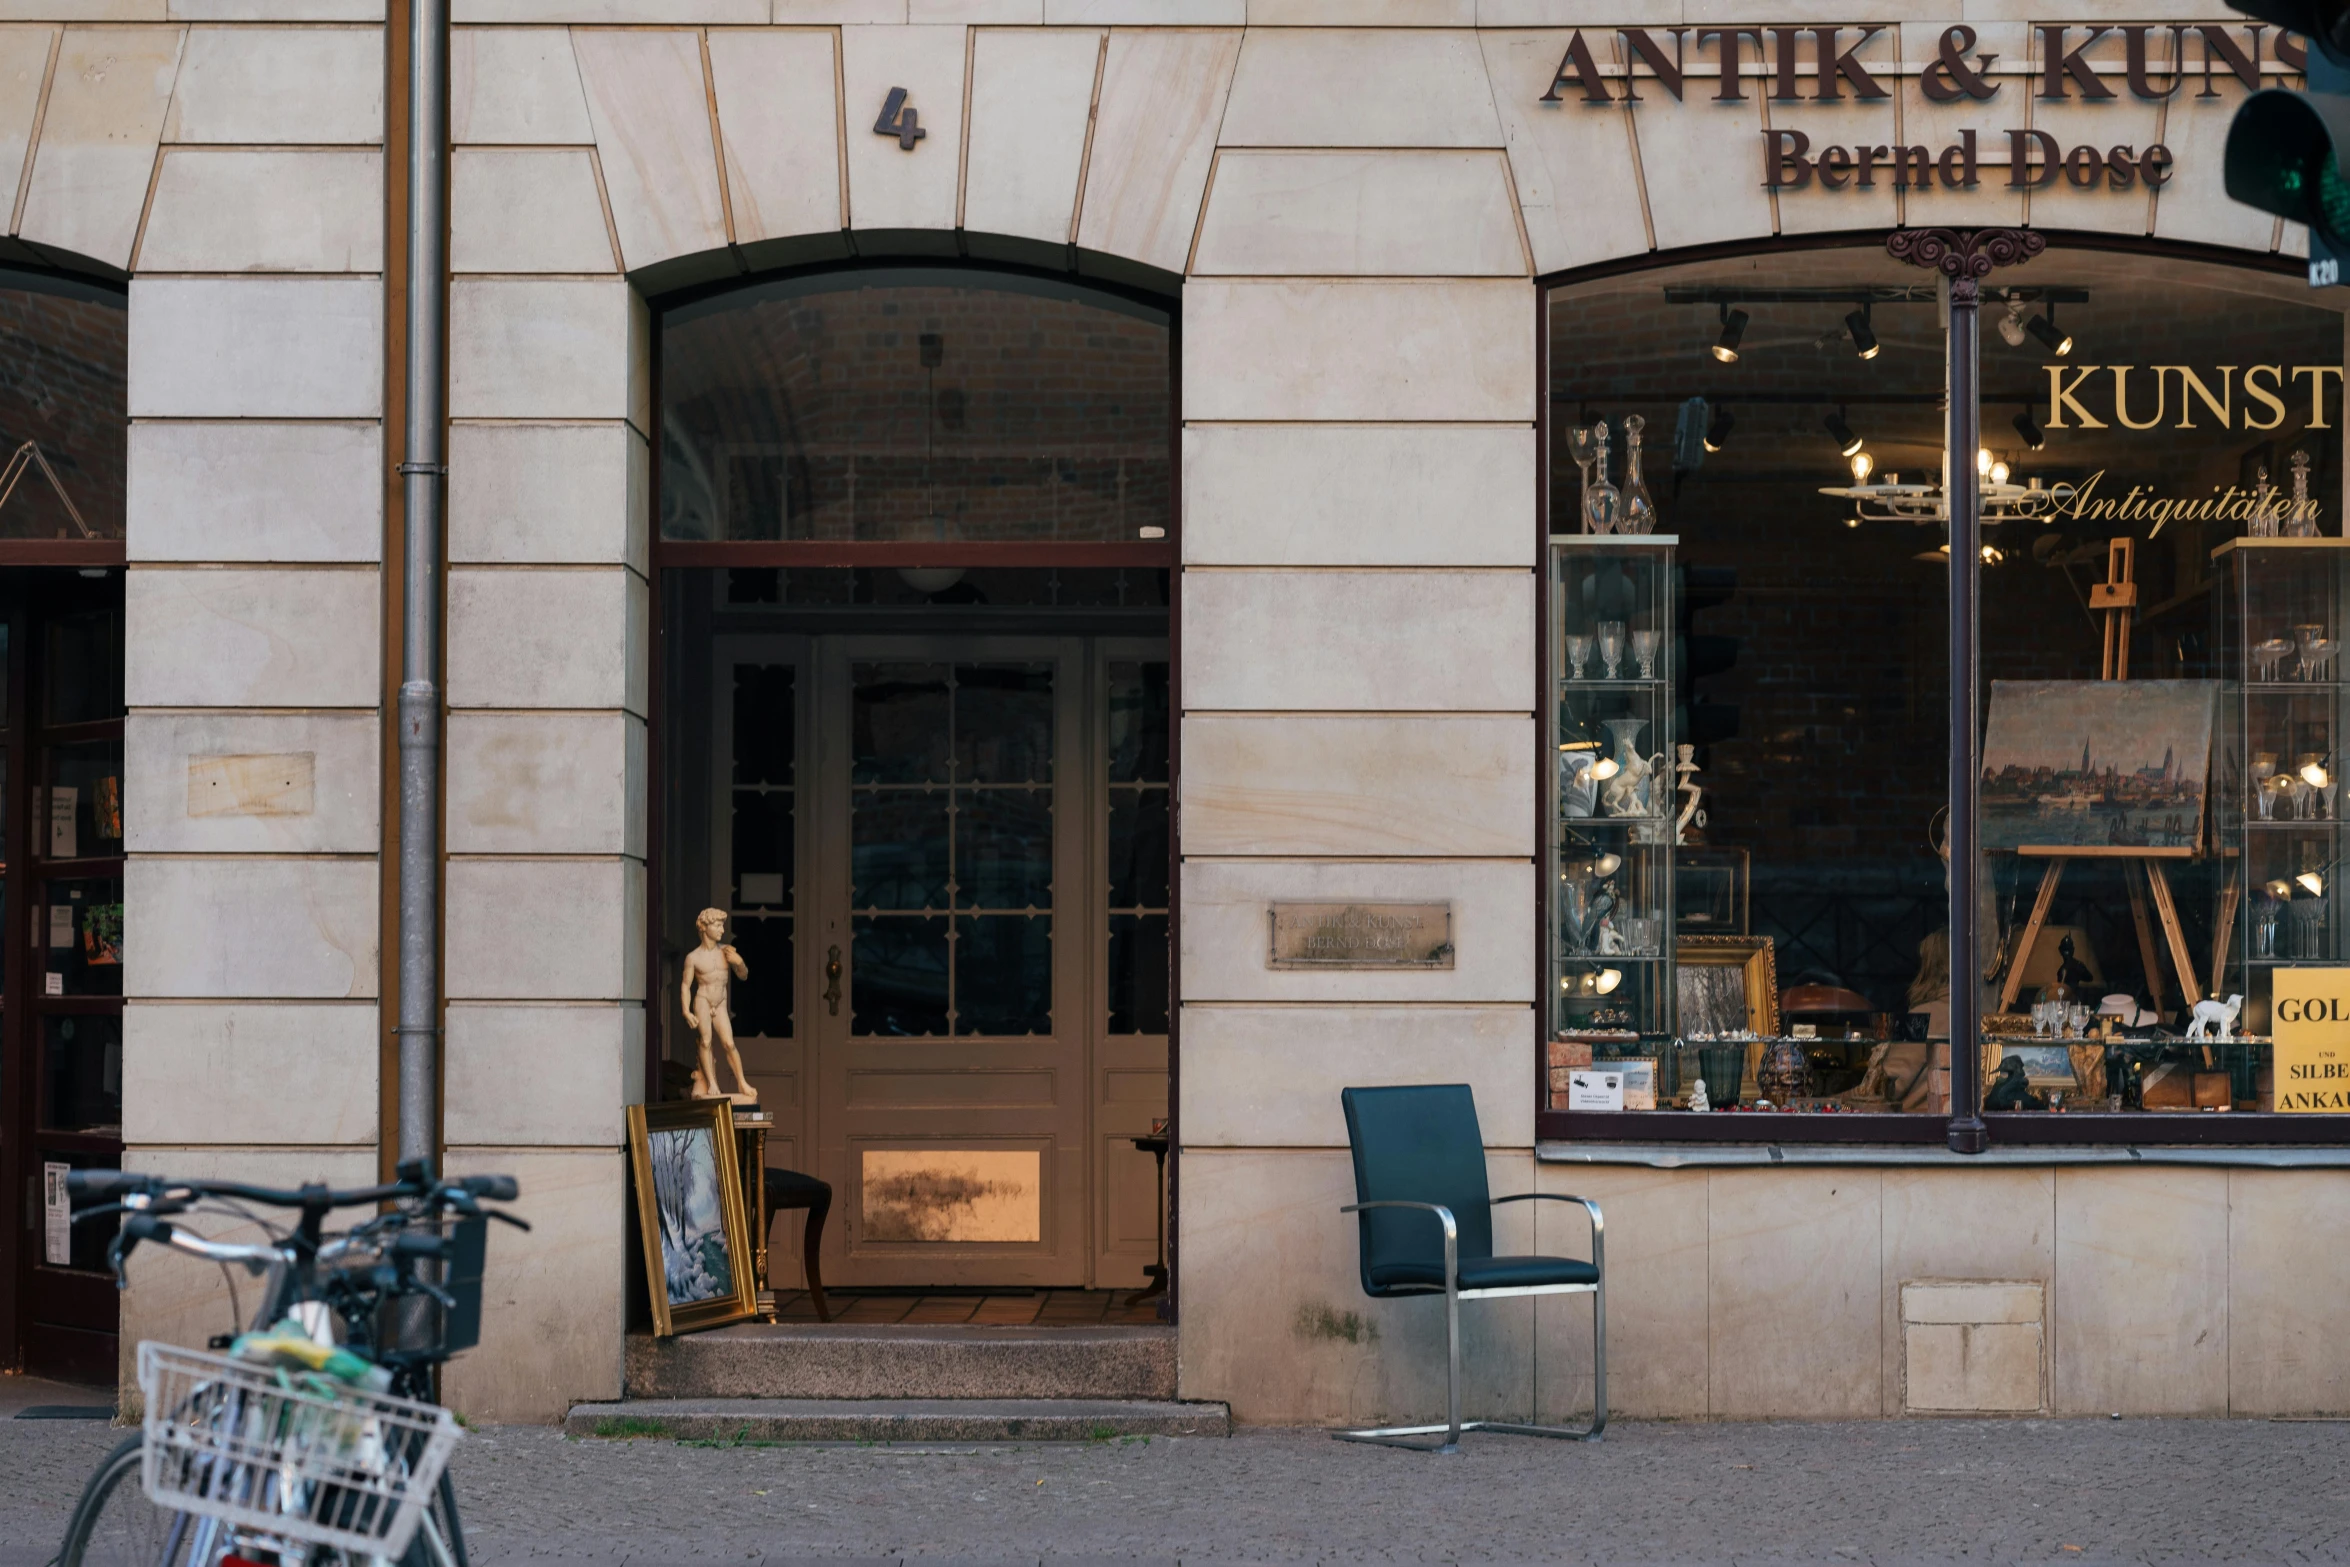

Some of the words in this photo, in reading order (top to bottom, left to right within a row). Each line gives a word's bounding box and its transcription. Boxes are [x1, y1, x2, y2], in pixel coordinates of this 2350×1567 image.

[1539, 26, 1892, 102] ANTIK
[1920, 24, 2001, 101] &
[873, 86, 926, 151] 4
[1760, 129, 1981, 187] Bernd
[2003, 129, 2173, 187] Dose
[2042, 365, 2344, 430] KUNST
[2017, 469, 2323, 539] Antiquitäten
[1290, 914, 1344, 929] ANTIK
[1348, 914, 1361, 929] &
[1367, 914, 1422, 930] KUNST
[1308, 935, 1359, 949] BERND
[2277, 998, 2350, 1022] GOL
[2290, 1063, 2349, 1079] SILBE
